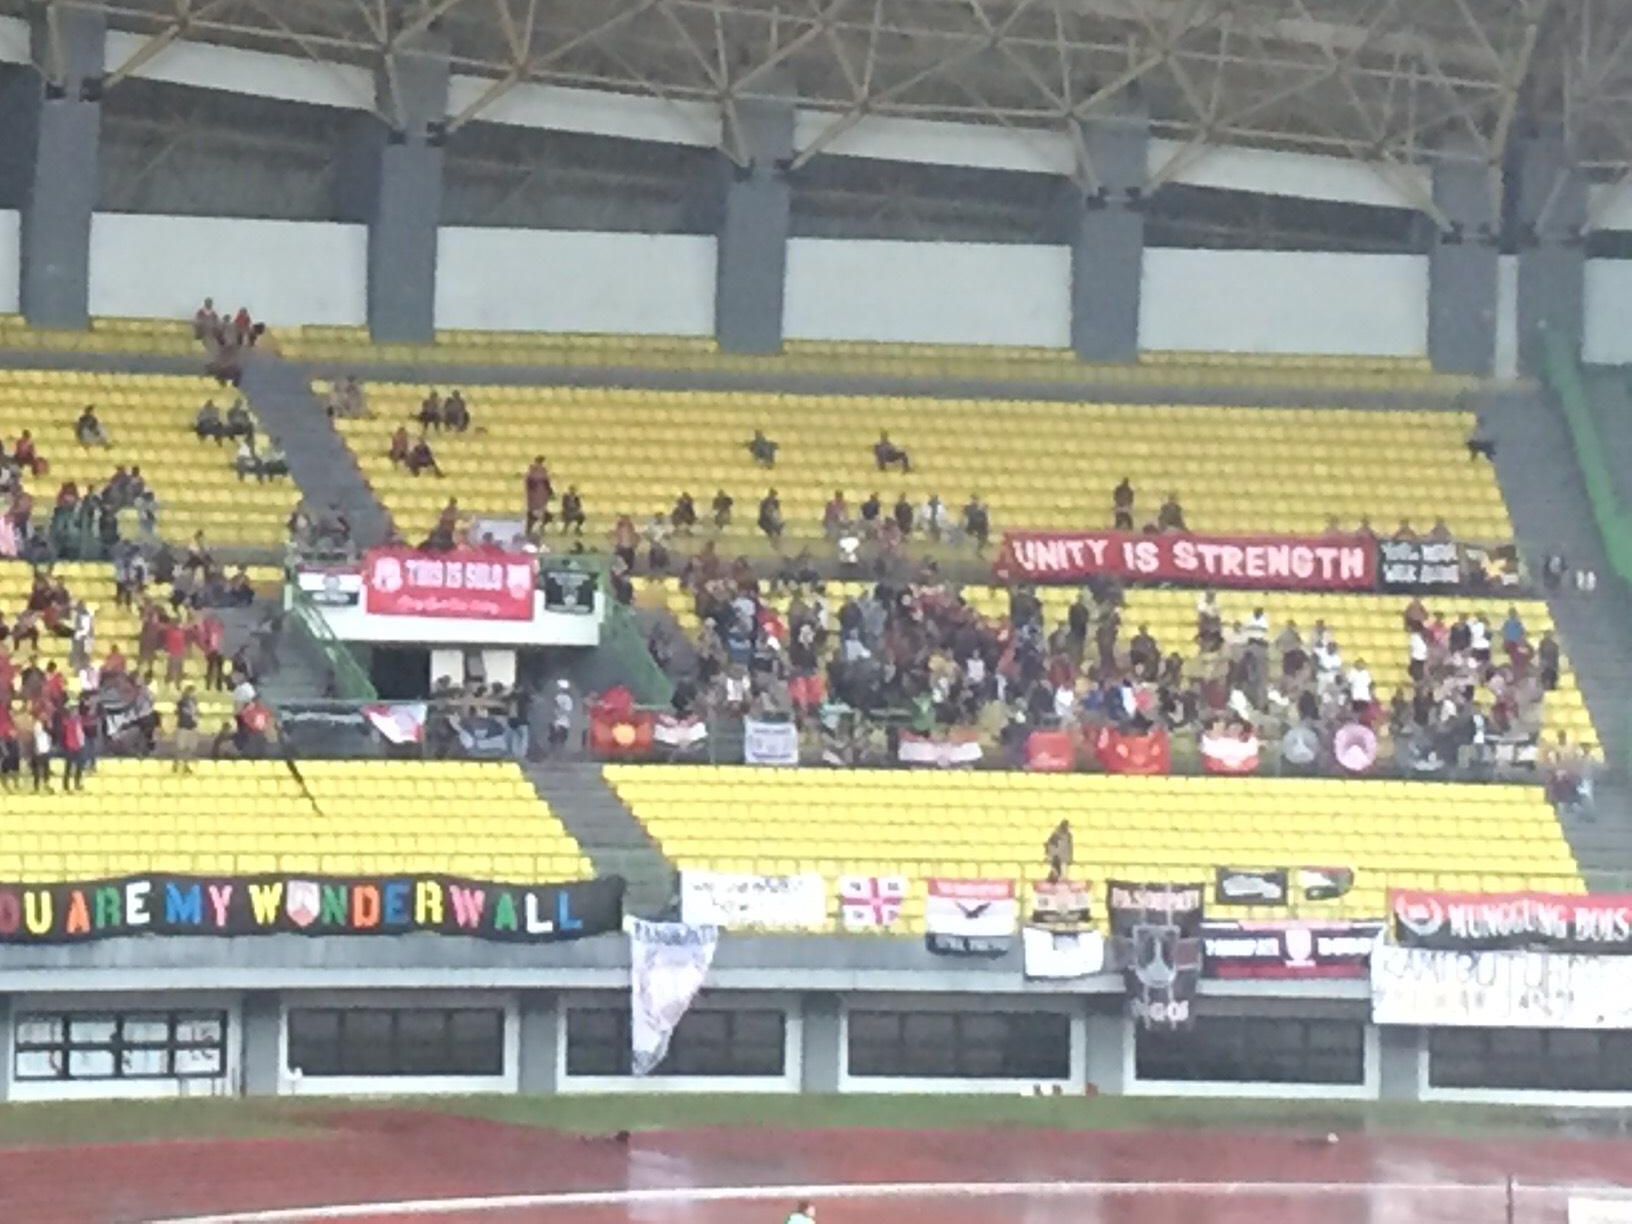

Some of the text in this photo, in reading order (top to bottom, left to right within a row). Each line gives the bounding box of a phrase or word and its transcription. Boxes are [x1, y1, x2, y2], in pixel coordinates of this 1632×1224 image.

[1013, 539, 1109, 571] UNITY
[1122, 541, 1161, 573] IS
[1172, 540, 1364, 580] STRENGTH
[66, 881, 152, 928] ARE
[166, 883, 233, 928] MY
